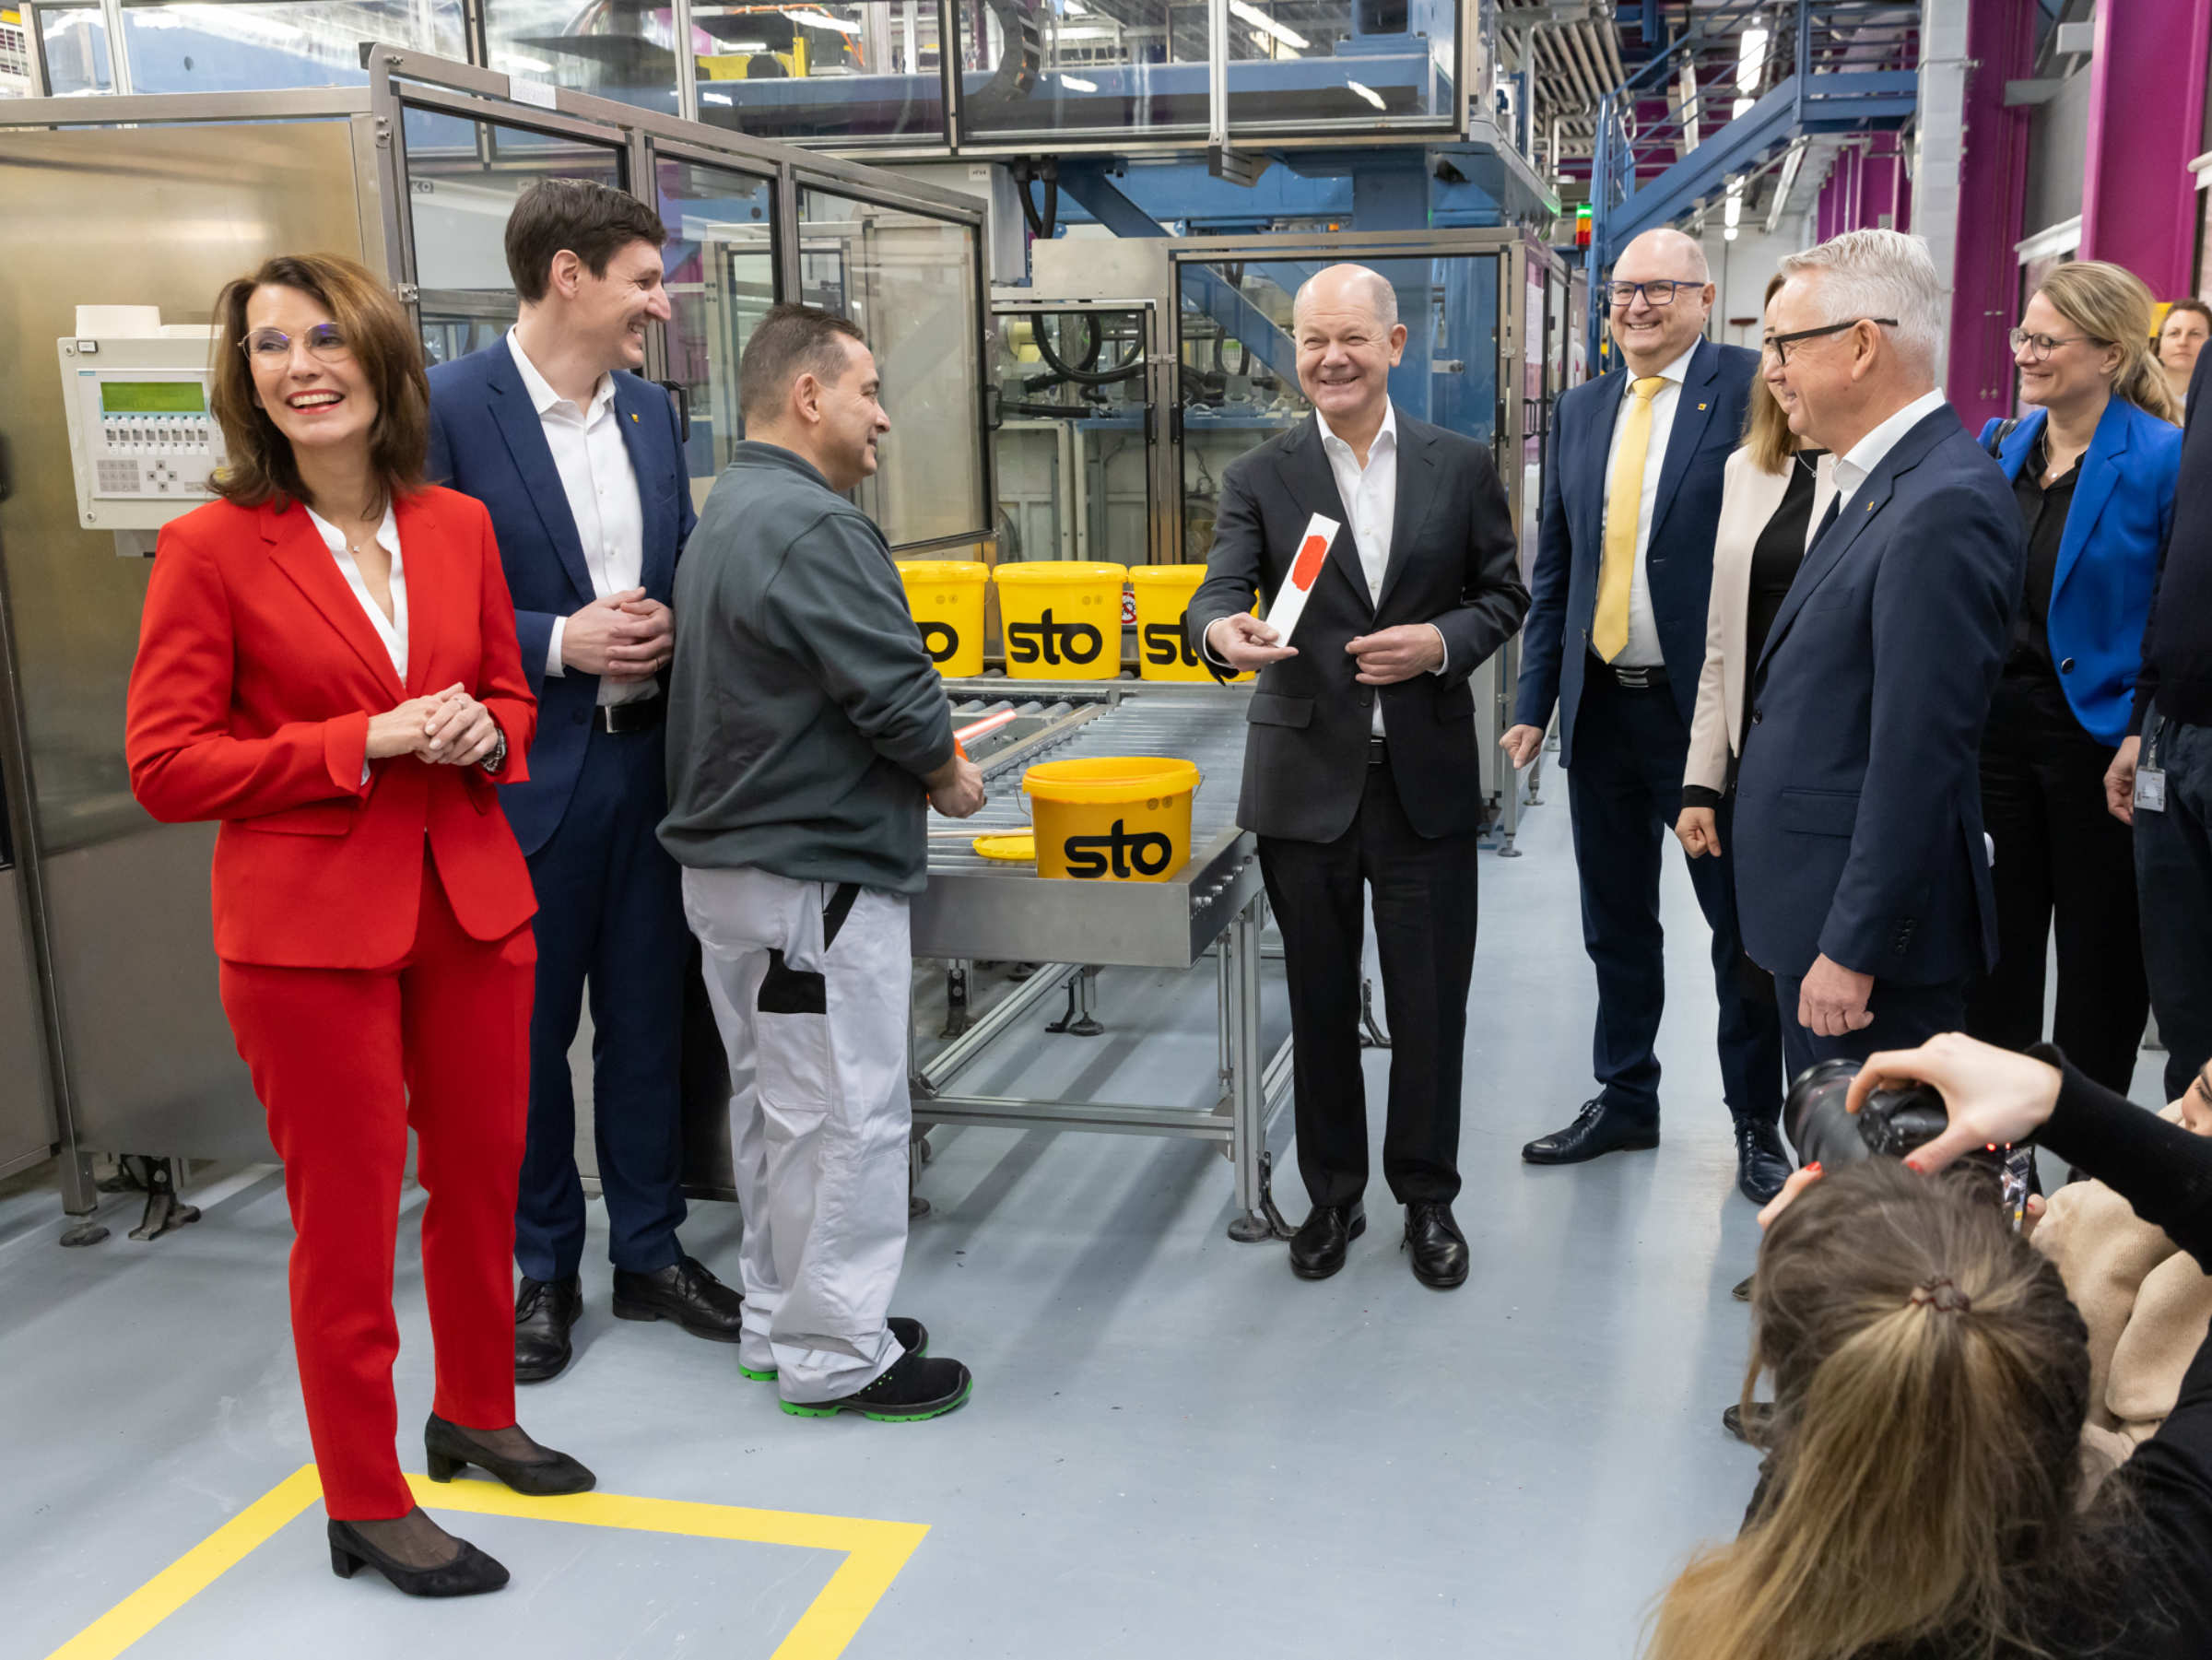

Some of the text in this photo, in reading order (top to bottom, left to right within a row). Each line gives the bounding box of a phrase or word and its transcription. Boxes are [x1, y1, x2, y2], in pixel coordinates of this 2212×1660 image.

[1008, 608, 1102, 665] sto
[1144, 609, 1198, 666] st
[1065, 818, 1171, 878] sto
